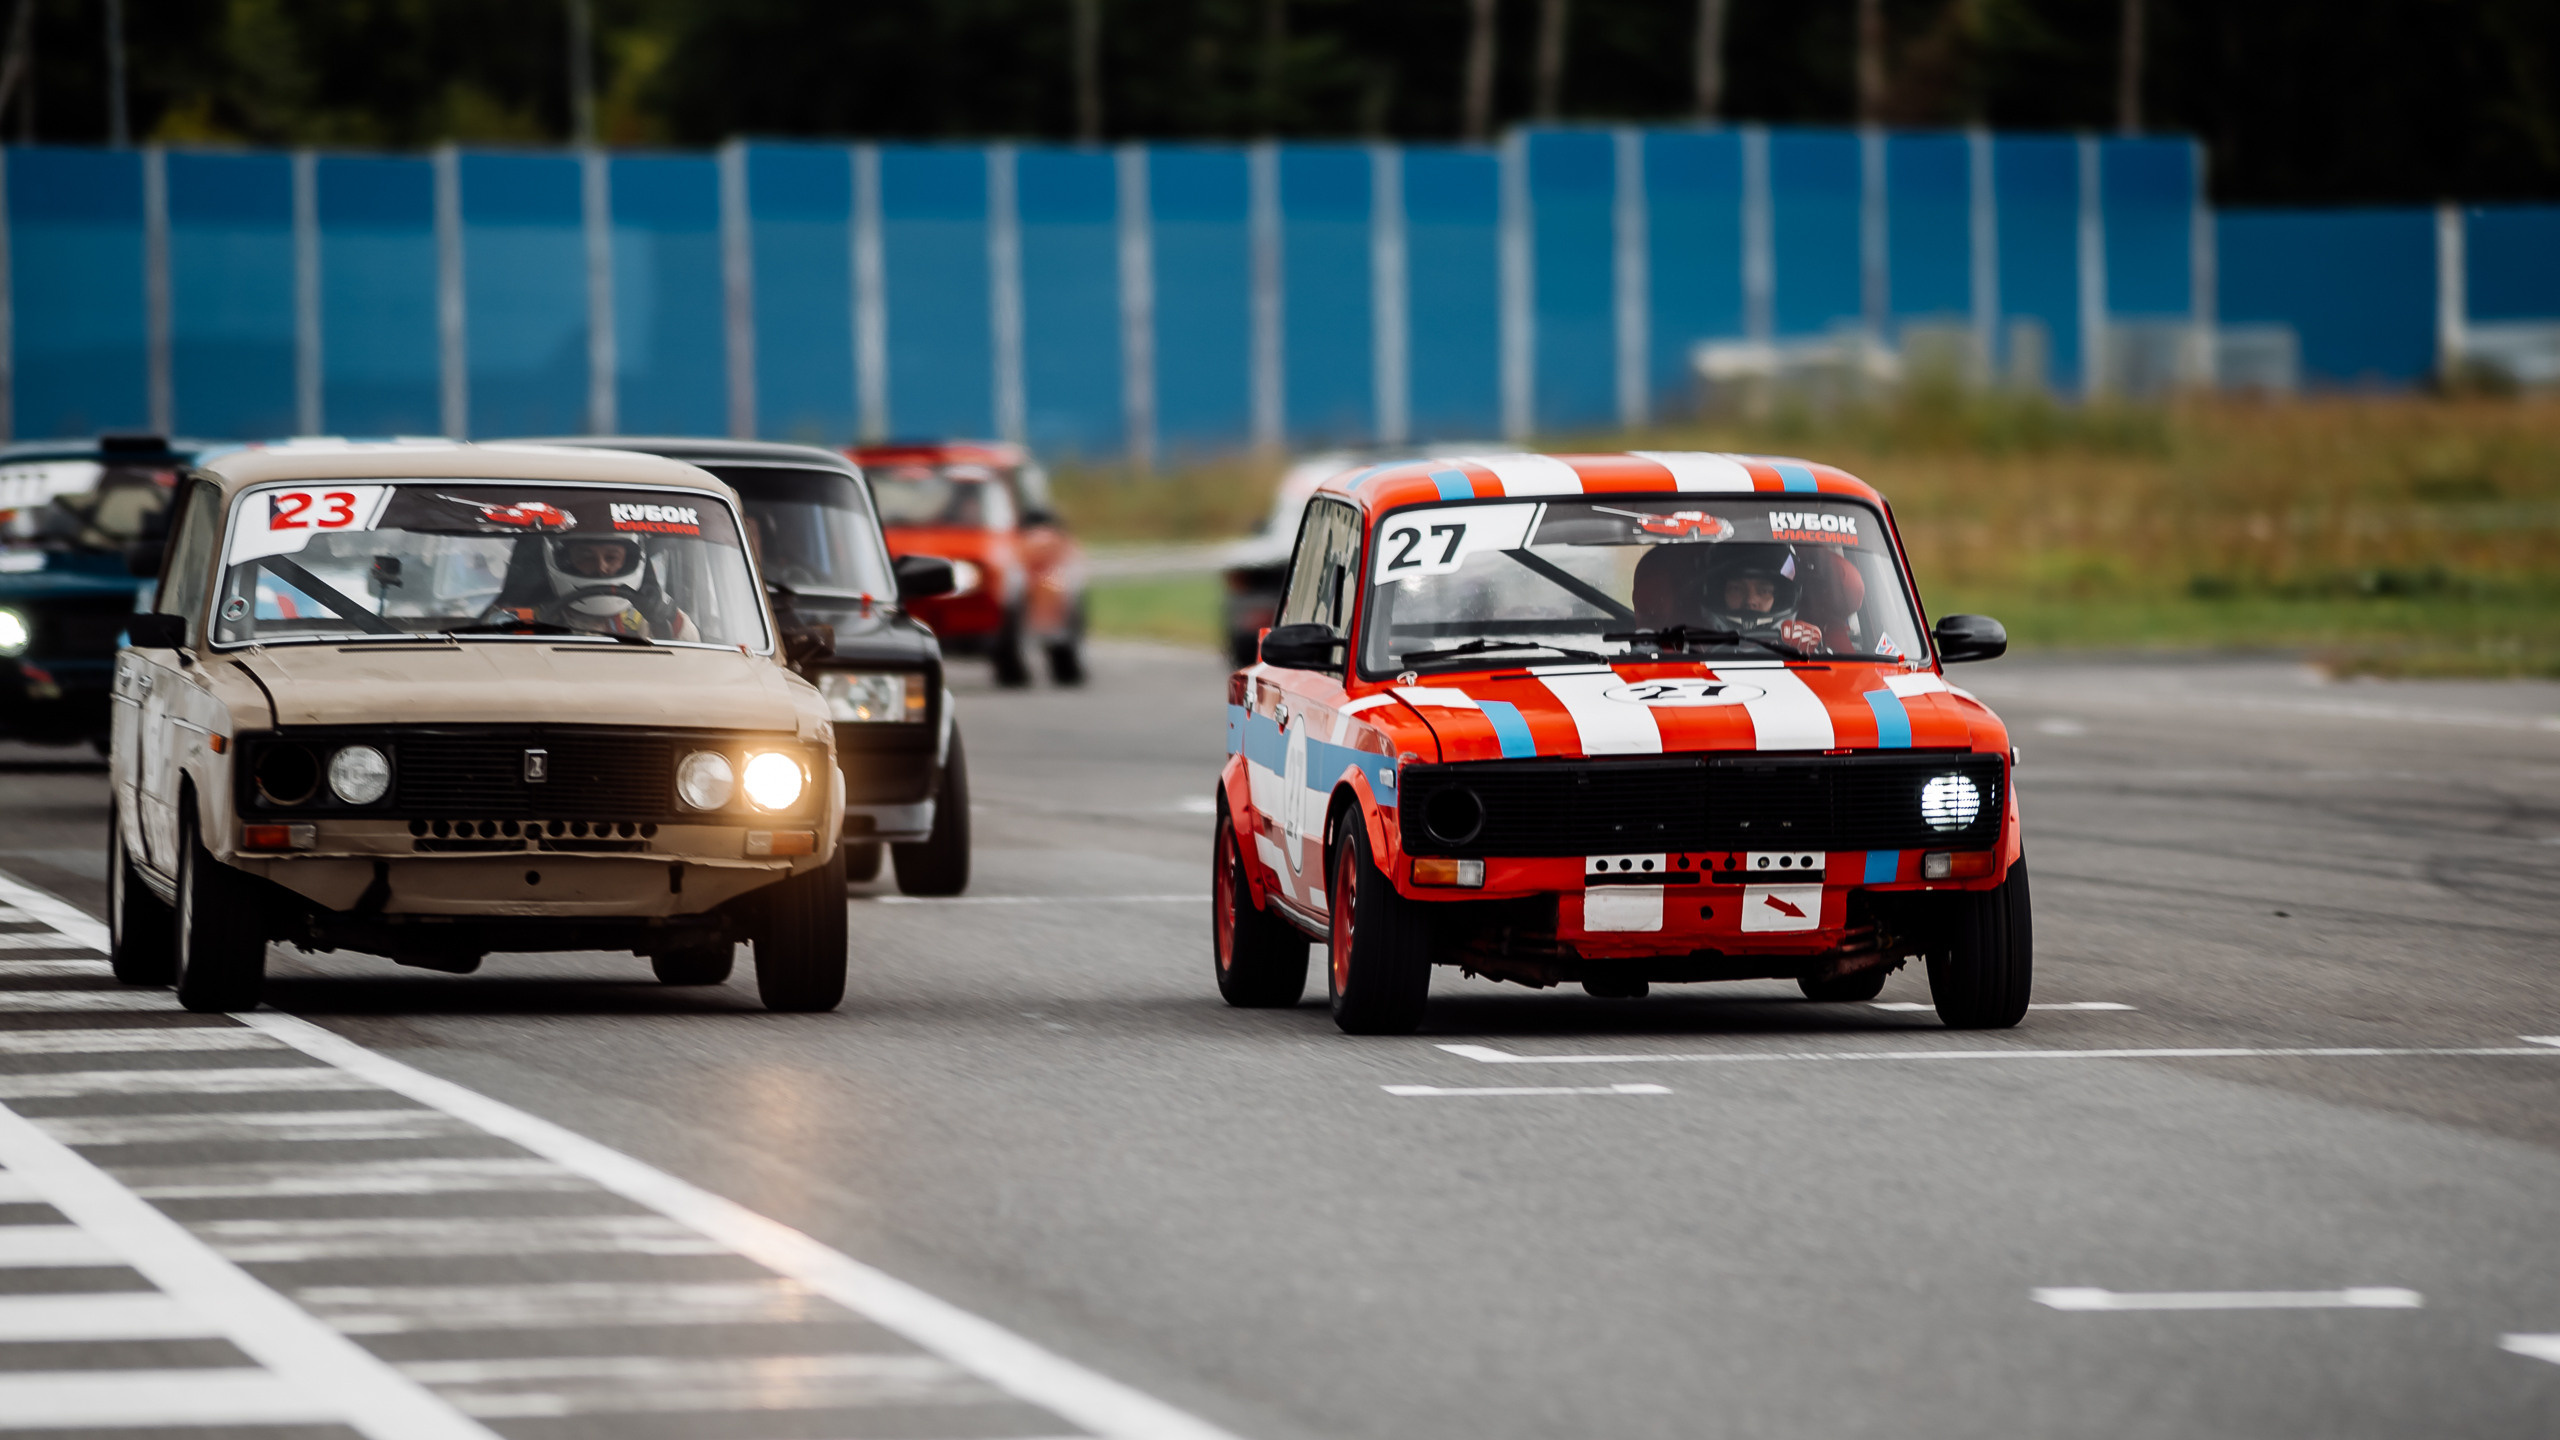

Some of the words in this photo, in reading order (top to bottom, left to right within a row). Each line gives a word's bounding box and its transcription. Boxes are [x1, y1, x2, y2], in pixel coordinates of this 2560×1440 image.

[270, 492, 356, 530] 23
[609, 503, 699, 525] КУБОК
[1769, 512, 1857, 535] КУБОК
[1388, 523, 1466, 571] 27
[1772, 529, 1859, 546] КЛАССИКИ
[1630, 685, 1729, 701] 27
